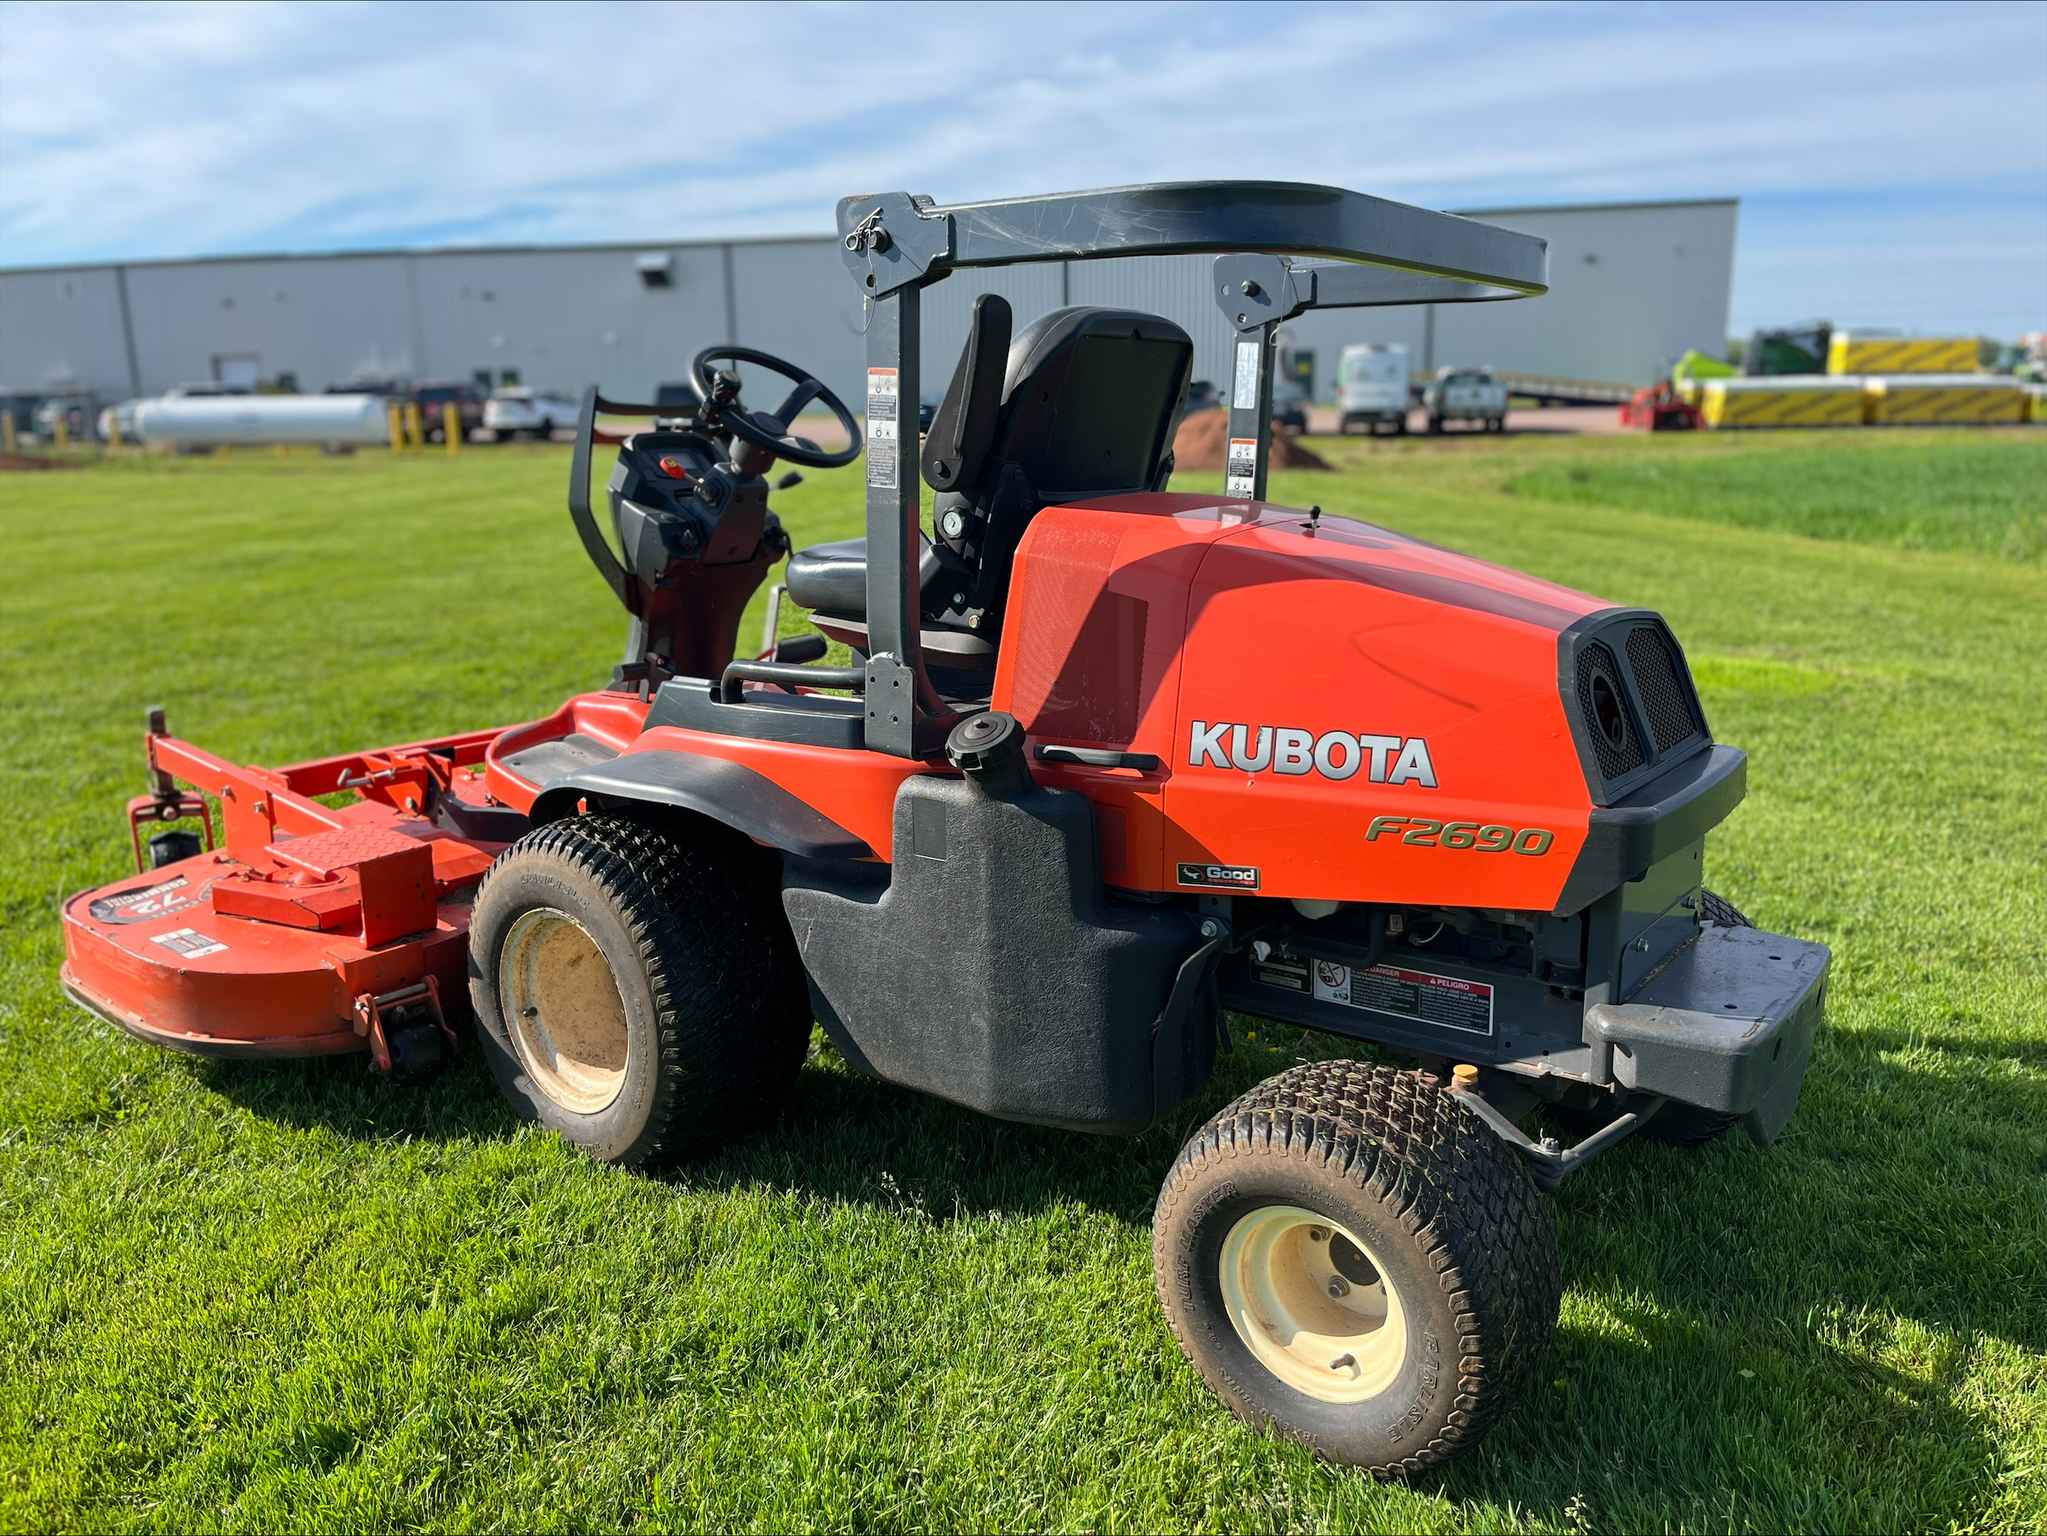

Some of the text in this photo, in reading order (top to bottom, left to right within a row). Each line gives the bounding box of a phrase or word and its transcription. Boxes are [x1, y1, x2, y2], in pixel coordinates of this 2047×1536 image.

[1188, 720, 1439, 788] KUBOTA
[1365, 815, 1555, 856] F2690
[1206, 866, 1256, 881] Good
[103, 877, 190, 908] COMMERCIAL
[128, 892, 188, 915] 72
[1370, 966, 1400, 977] DANGER
[1437, 978, 1470, 991] PELIGRO
[1177, 1180, 1237, 1313] TURF MASTER
[1386, 1331, 1440, 1444] CARLISLE
